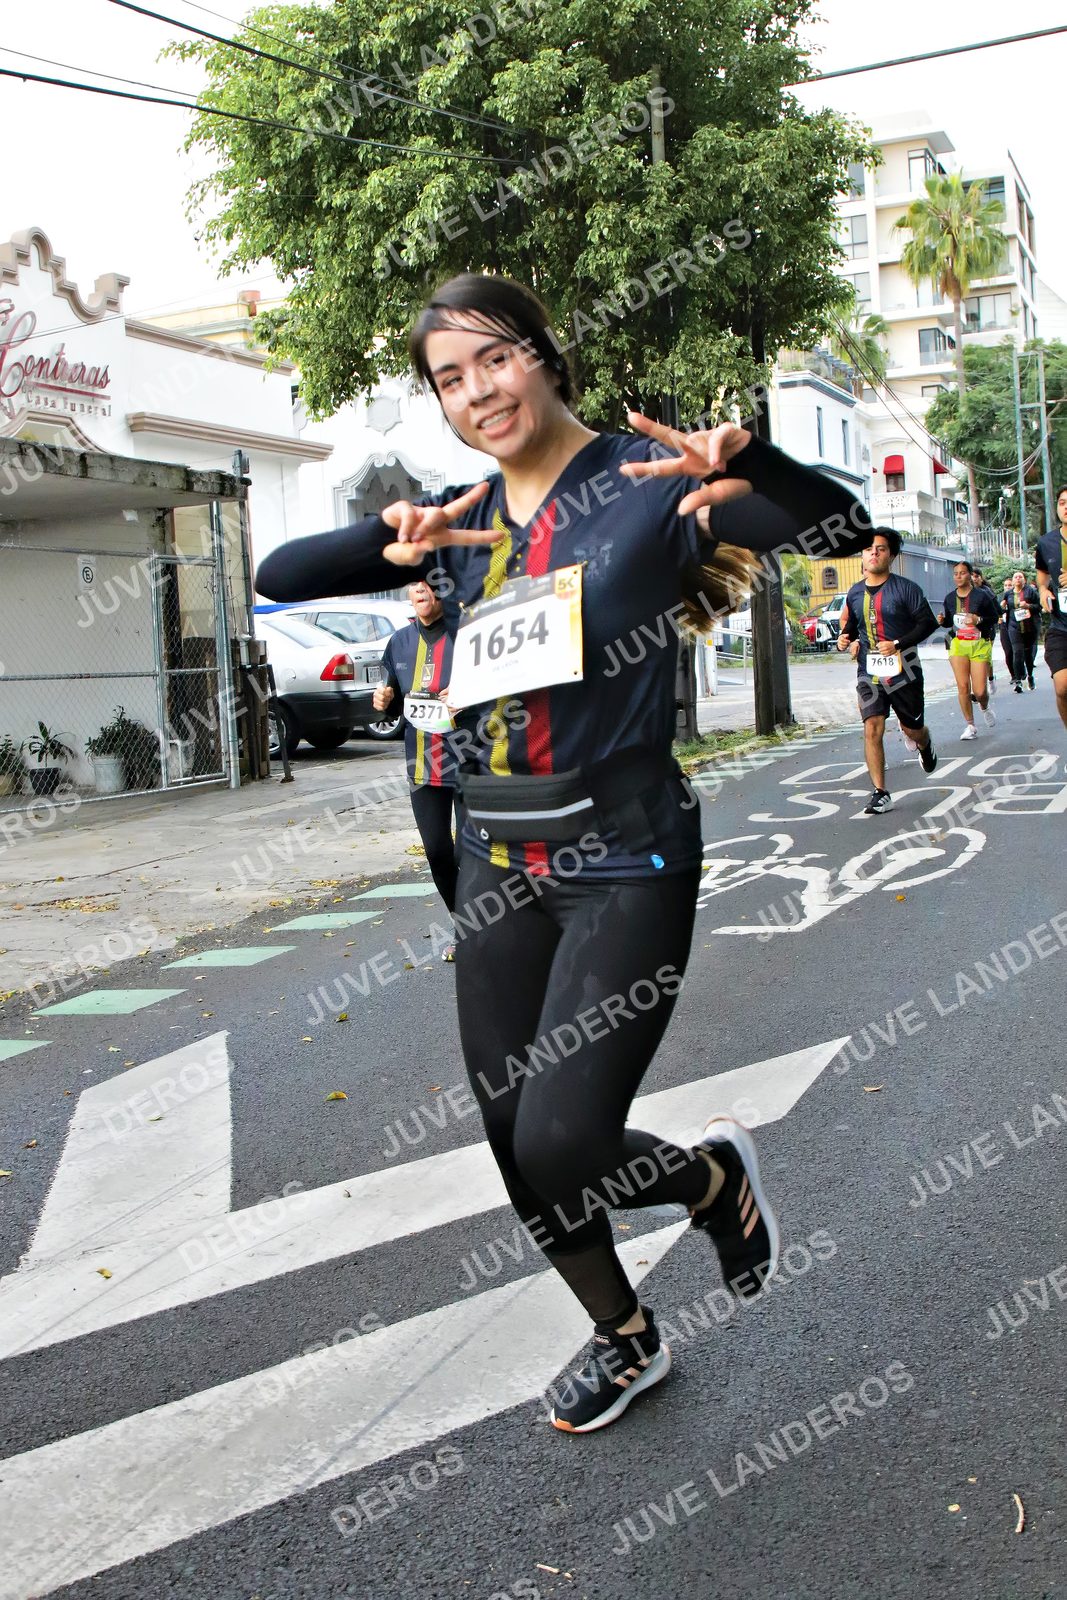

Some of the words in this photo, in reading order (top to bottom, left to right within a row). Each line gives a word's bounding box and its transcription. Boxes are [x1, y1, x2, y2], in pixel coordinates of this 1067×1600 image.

[469, 610, 549, 667] 1654
[872, 657, 895, 667] 7618
[410, 704, 443, 719] 2371
